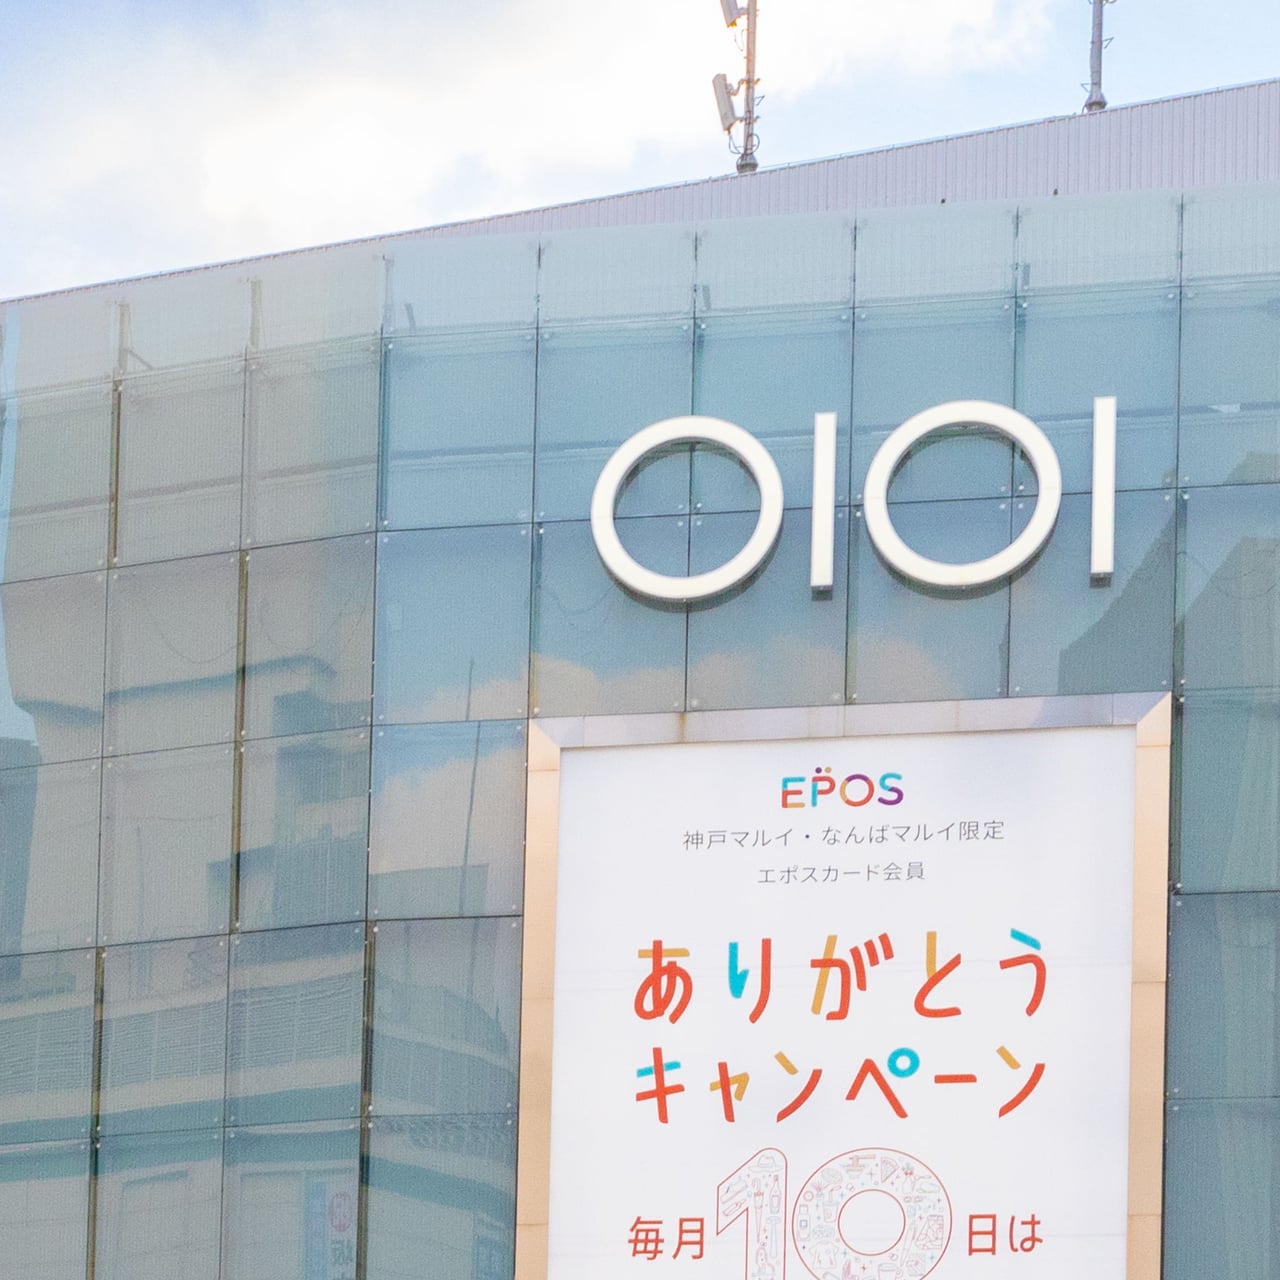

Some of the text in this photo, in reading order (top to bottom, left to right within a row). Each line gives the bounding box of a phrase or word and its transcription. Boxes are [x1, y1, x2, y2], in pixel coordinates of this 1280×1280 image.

[781, 766, 904, 809] EPOS
[682, 819, 1005, 852] 神戸マルイ・なんばマルイ限定
[757, 861, 926, 885] エポスカード会員
[634, 928, 1048, 1025] ありがとう
[635, 1045, 1047, 1125] キャンペーン
